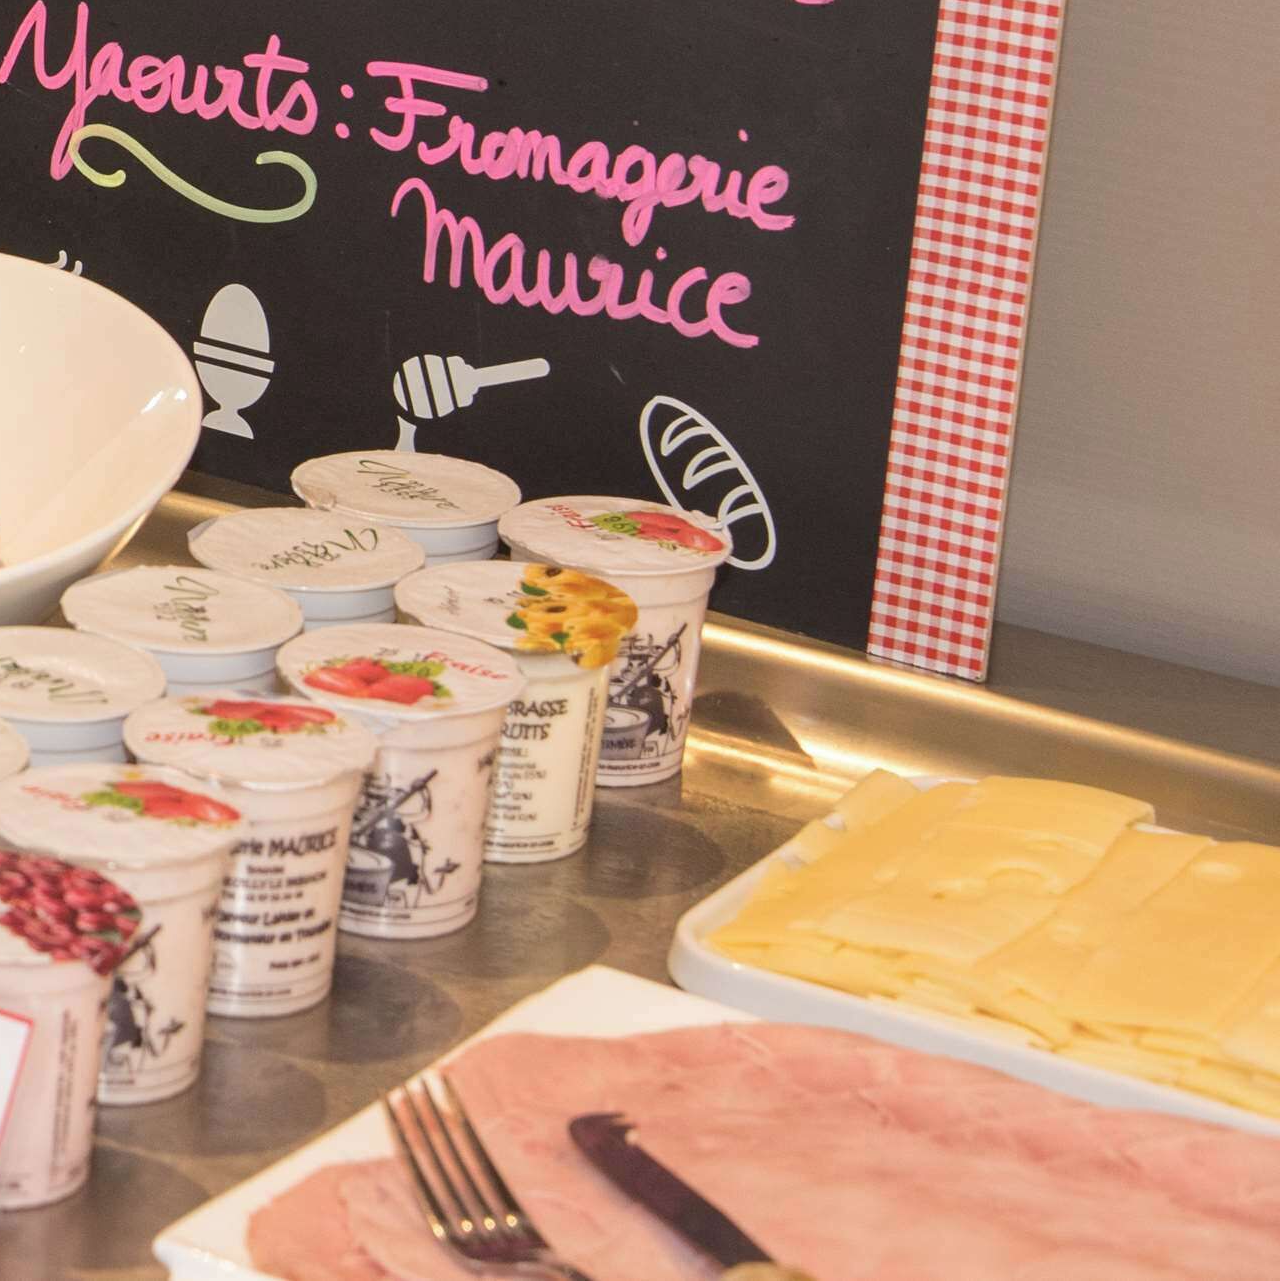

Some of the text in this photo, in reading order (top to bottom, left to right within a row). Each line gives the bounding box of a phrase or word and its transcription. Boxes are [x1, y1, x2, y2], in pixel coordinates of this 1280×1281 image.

[366, 61, 796, 244] Fromagerie
[391, 178, 759, 348] Maurice
[500, 722, 552, 741] RUITS
